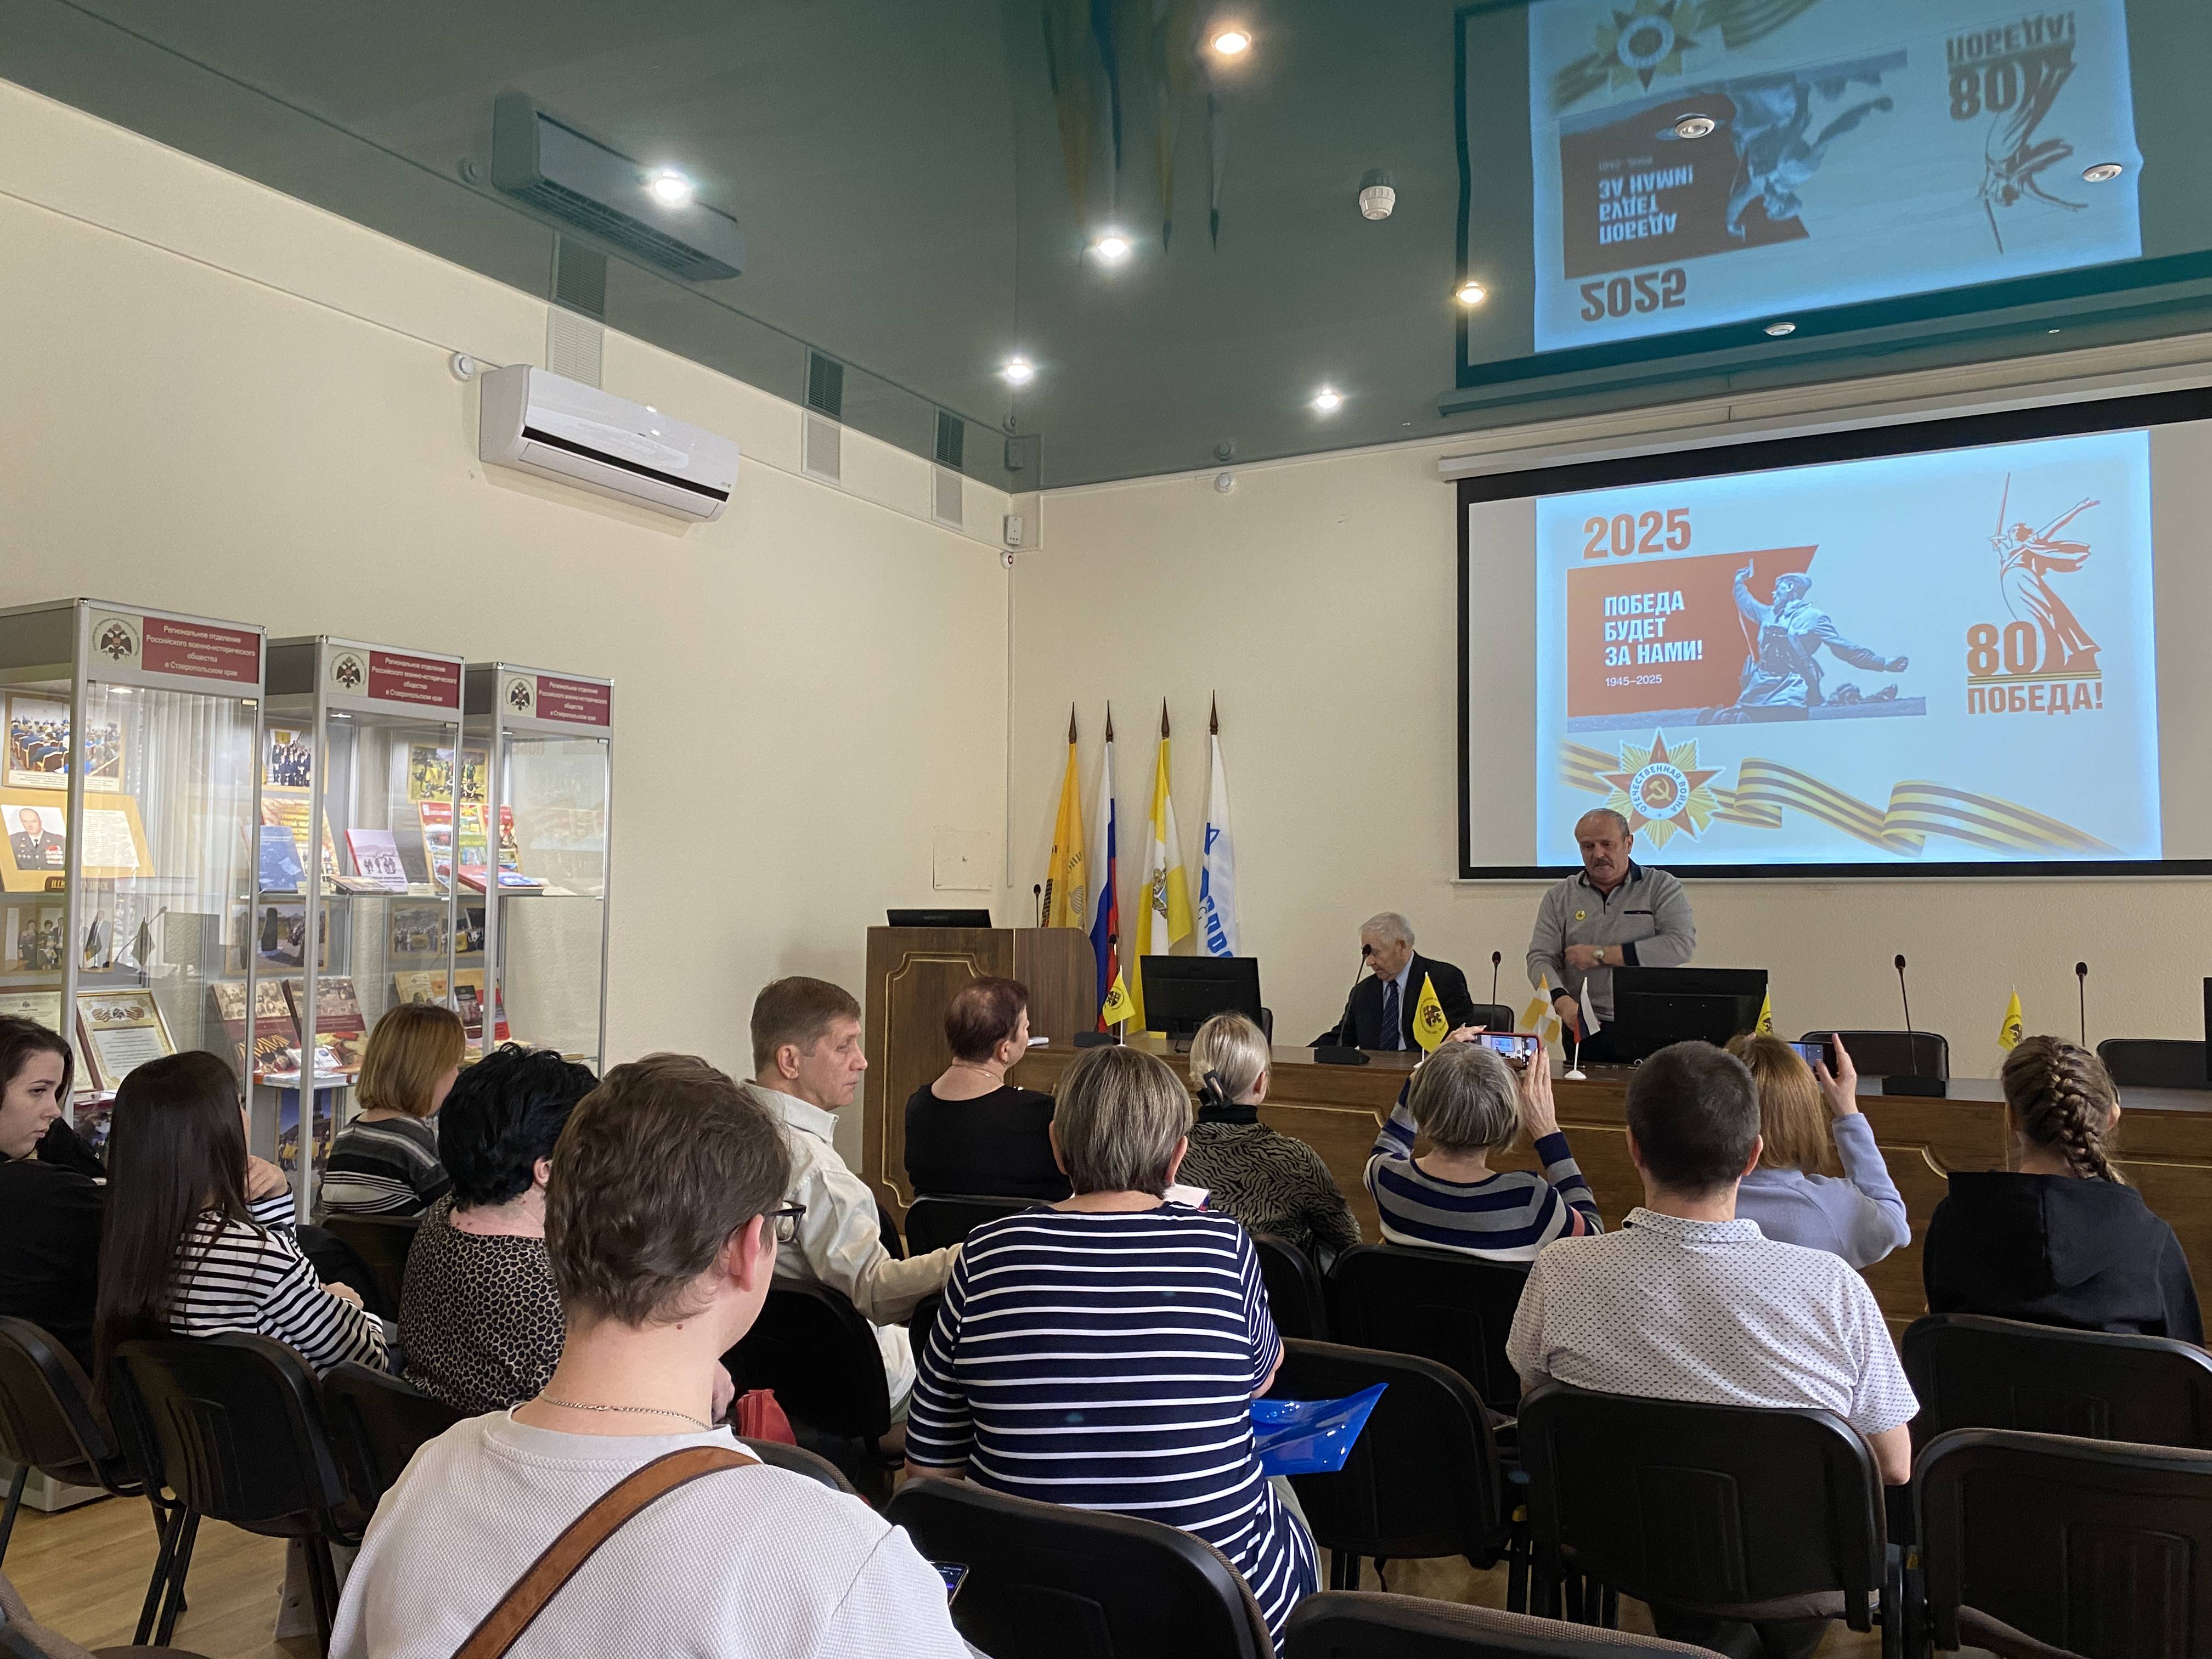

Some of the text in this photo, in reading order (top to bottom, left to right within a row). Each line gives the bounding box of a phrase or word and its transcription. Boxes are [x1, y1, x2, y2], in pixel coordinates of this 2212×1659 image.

[1583, 507, 1691, 560] 2025
[1604, 590, 1685, 617] ПОБЕДА
[146, 634, 188, 647] Российского
[1604, 617, 1666, 643] БУДЕТ
[1604, 640, 1703, 667] ЗА НАМИ!
[1967, 620, 2038, 676] 80
[1967, 682, 2103, 716] ПОБЕДА!
[1632, 765, 1681, 812] ОТЕЧЕСТВЕННАЯ
